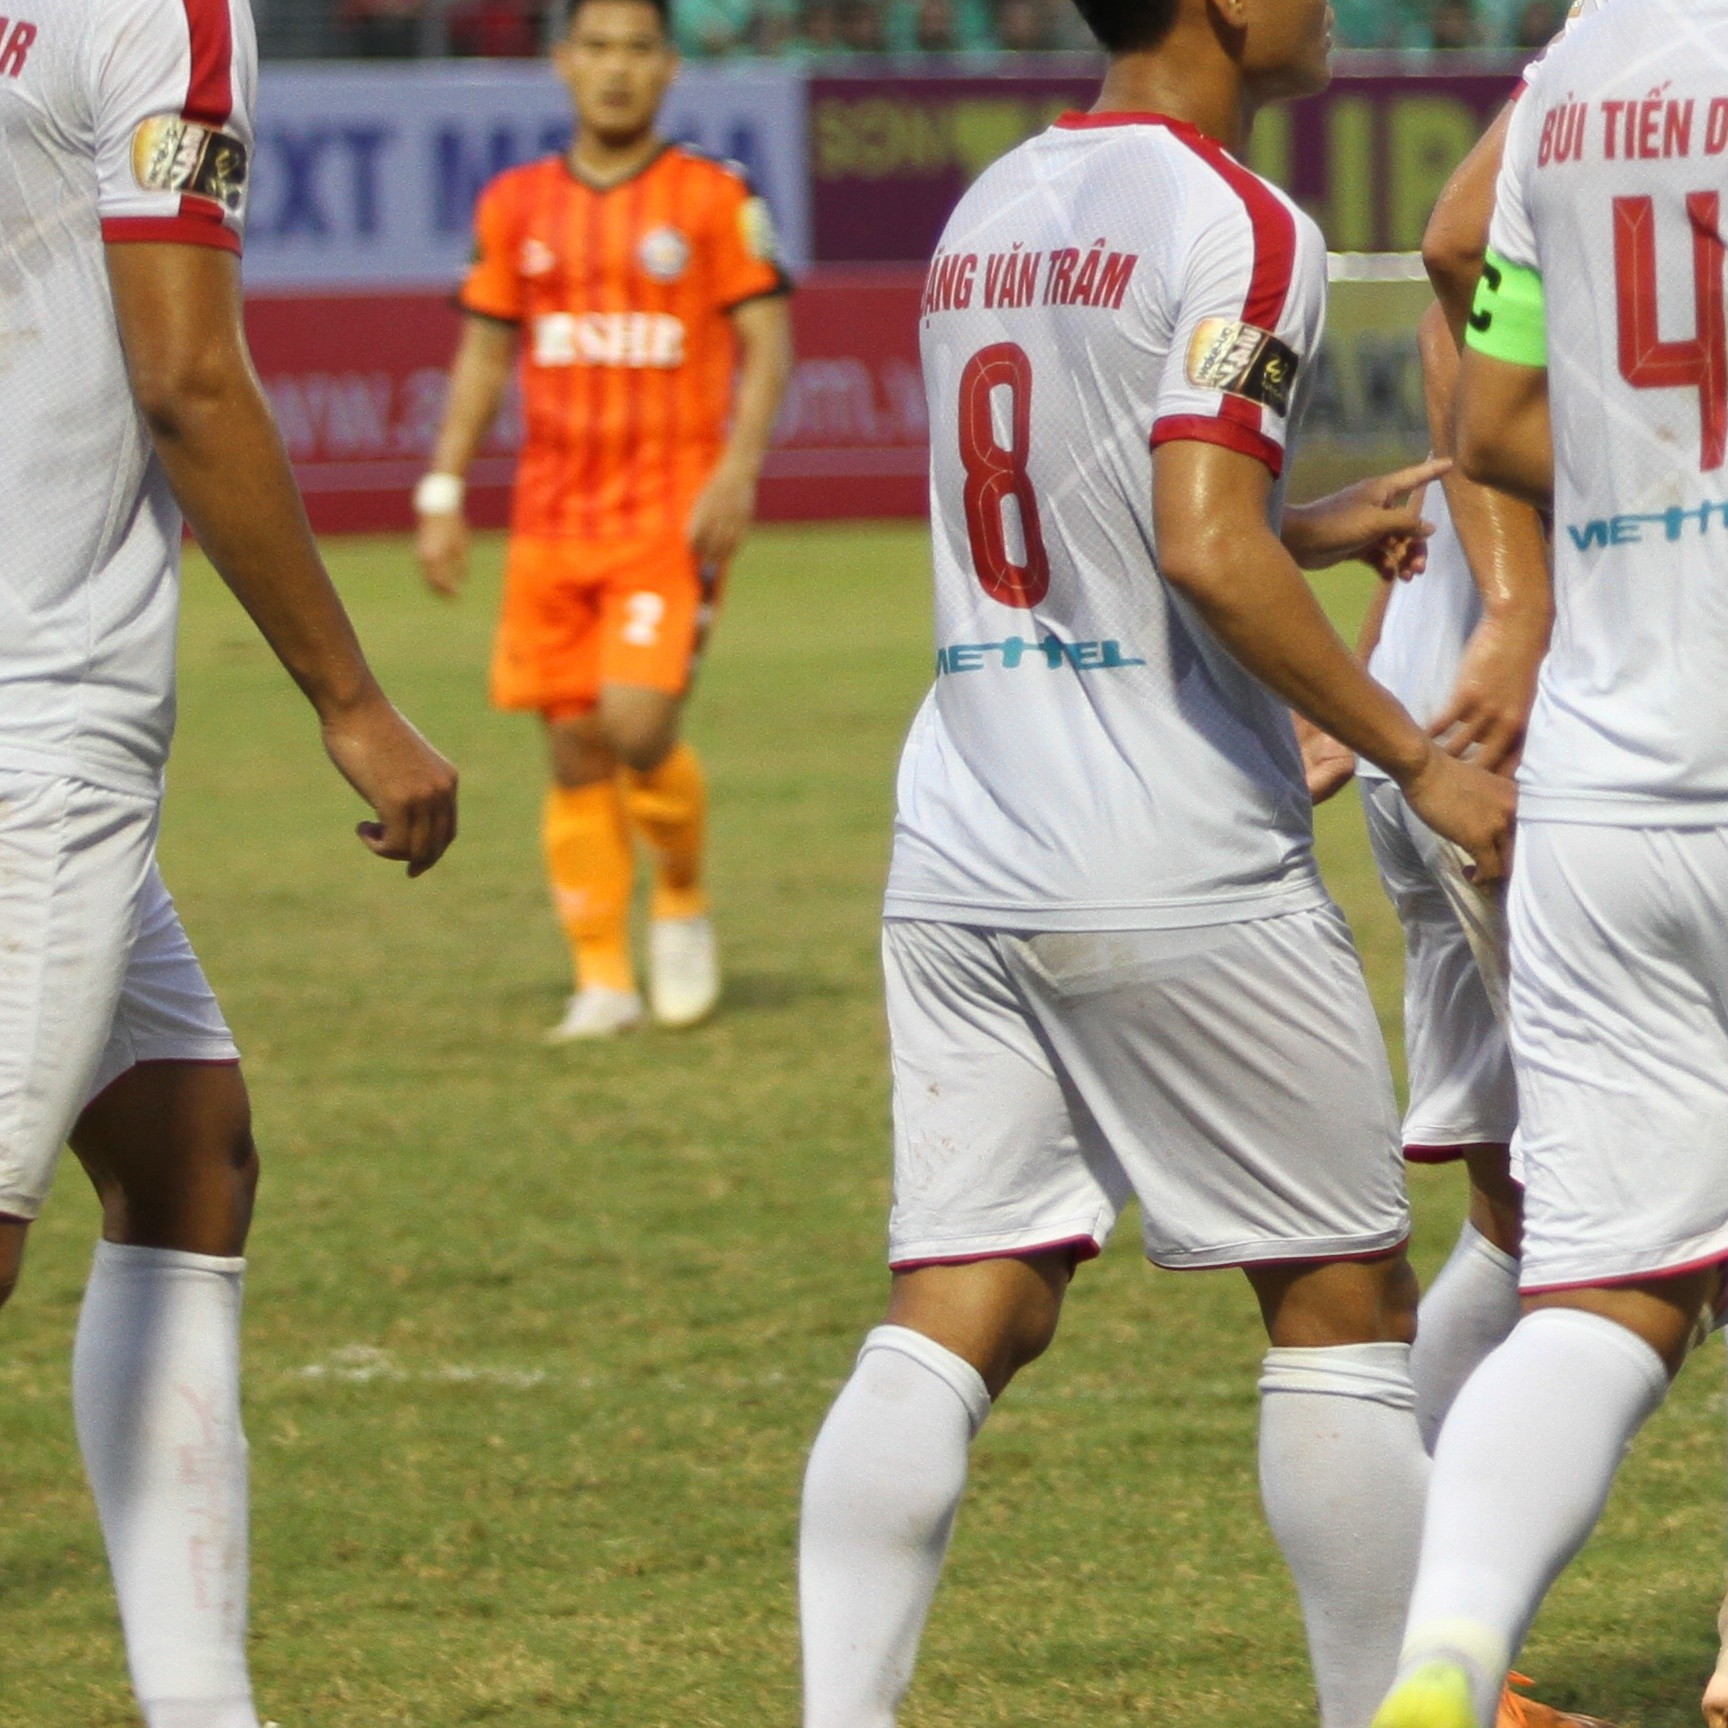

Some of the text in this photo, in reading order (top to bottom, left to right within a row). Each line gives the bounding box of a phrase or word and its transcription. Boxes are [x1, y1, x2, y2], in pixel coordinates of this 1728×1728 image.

[1601, 80, 1694, 160] TIẾN
[919, 237, 1138, 329] ẶNG VĂN TRÂM
[1612, 190, 1728, 471] 4
[957, 342, 1050, 609] 8
